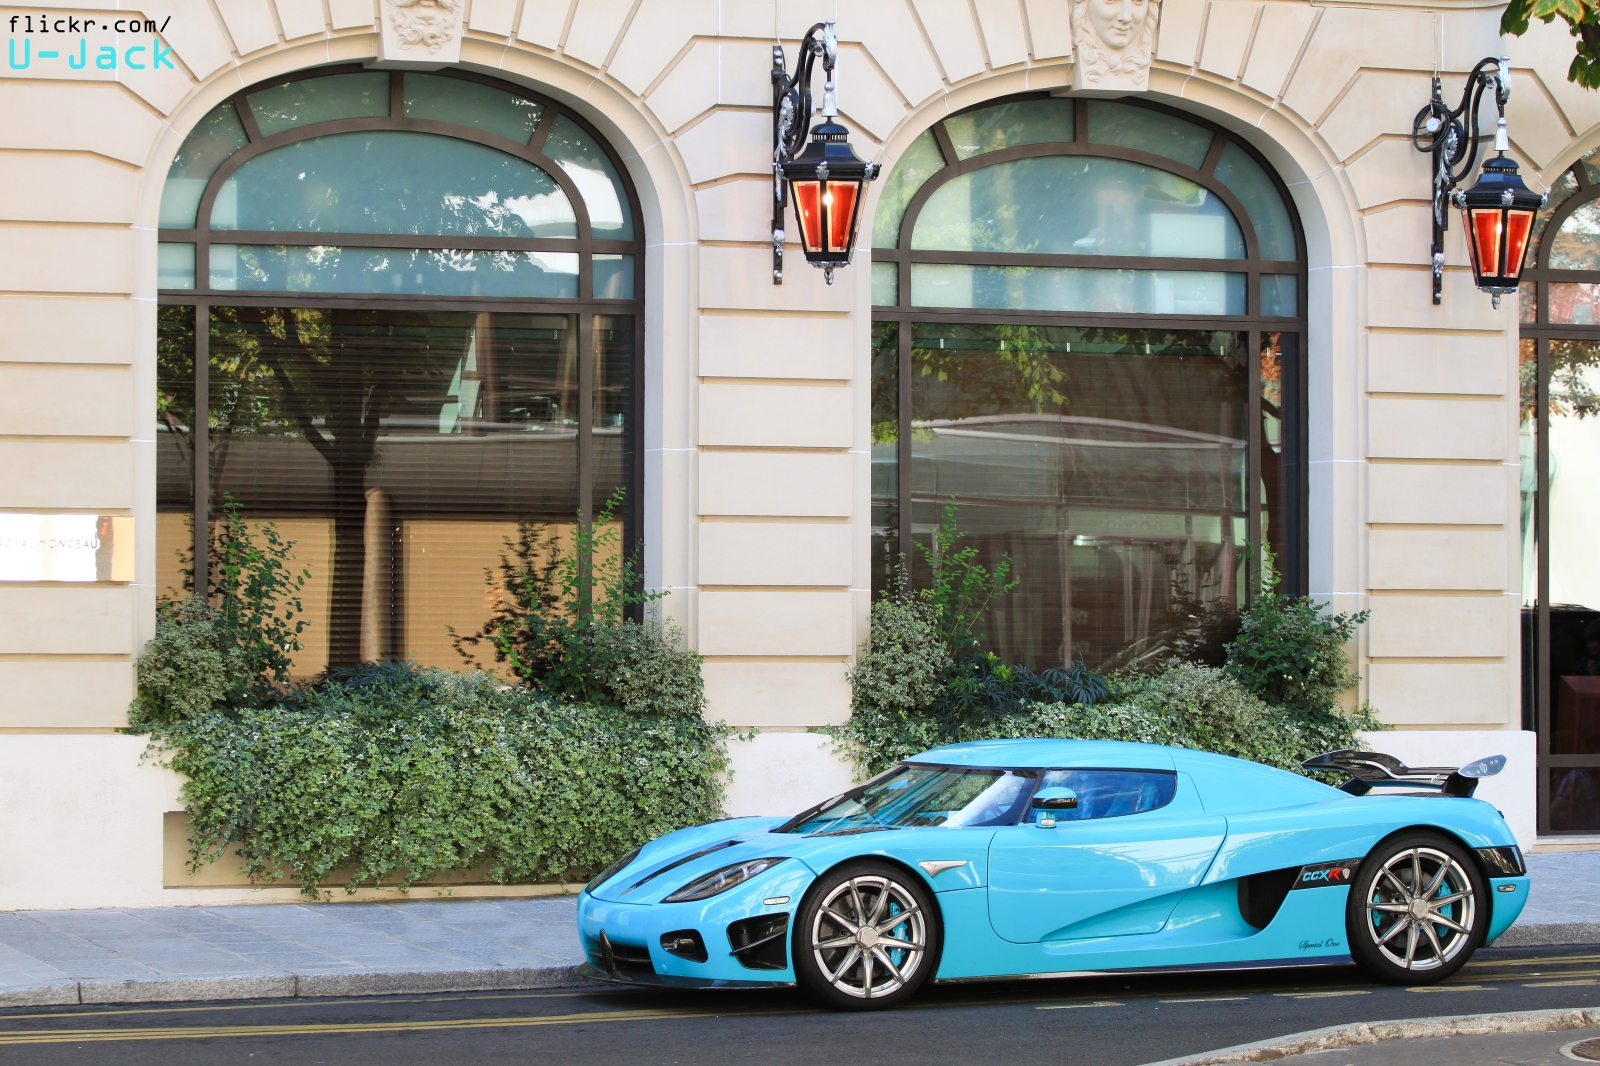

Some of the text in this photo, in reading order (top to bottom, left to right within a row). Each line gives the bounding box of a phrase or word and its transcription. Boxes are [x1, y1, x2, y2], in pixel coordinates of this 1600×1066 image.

[39, 538, 99, 549] MONCEAU
[1302, 867, 1342, 882] CCXR
[1298, 939, 1324, 952] Special
